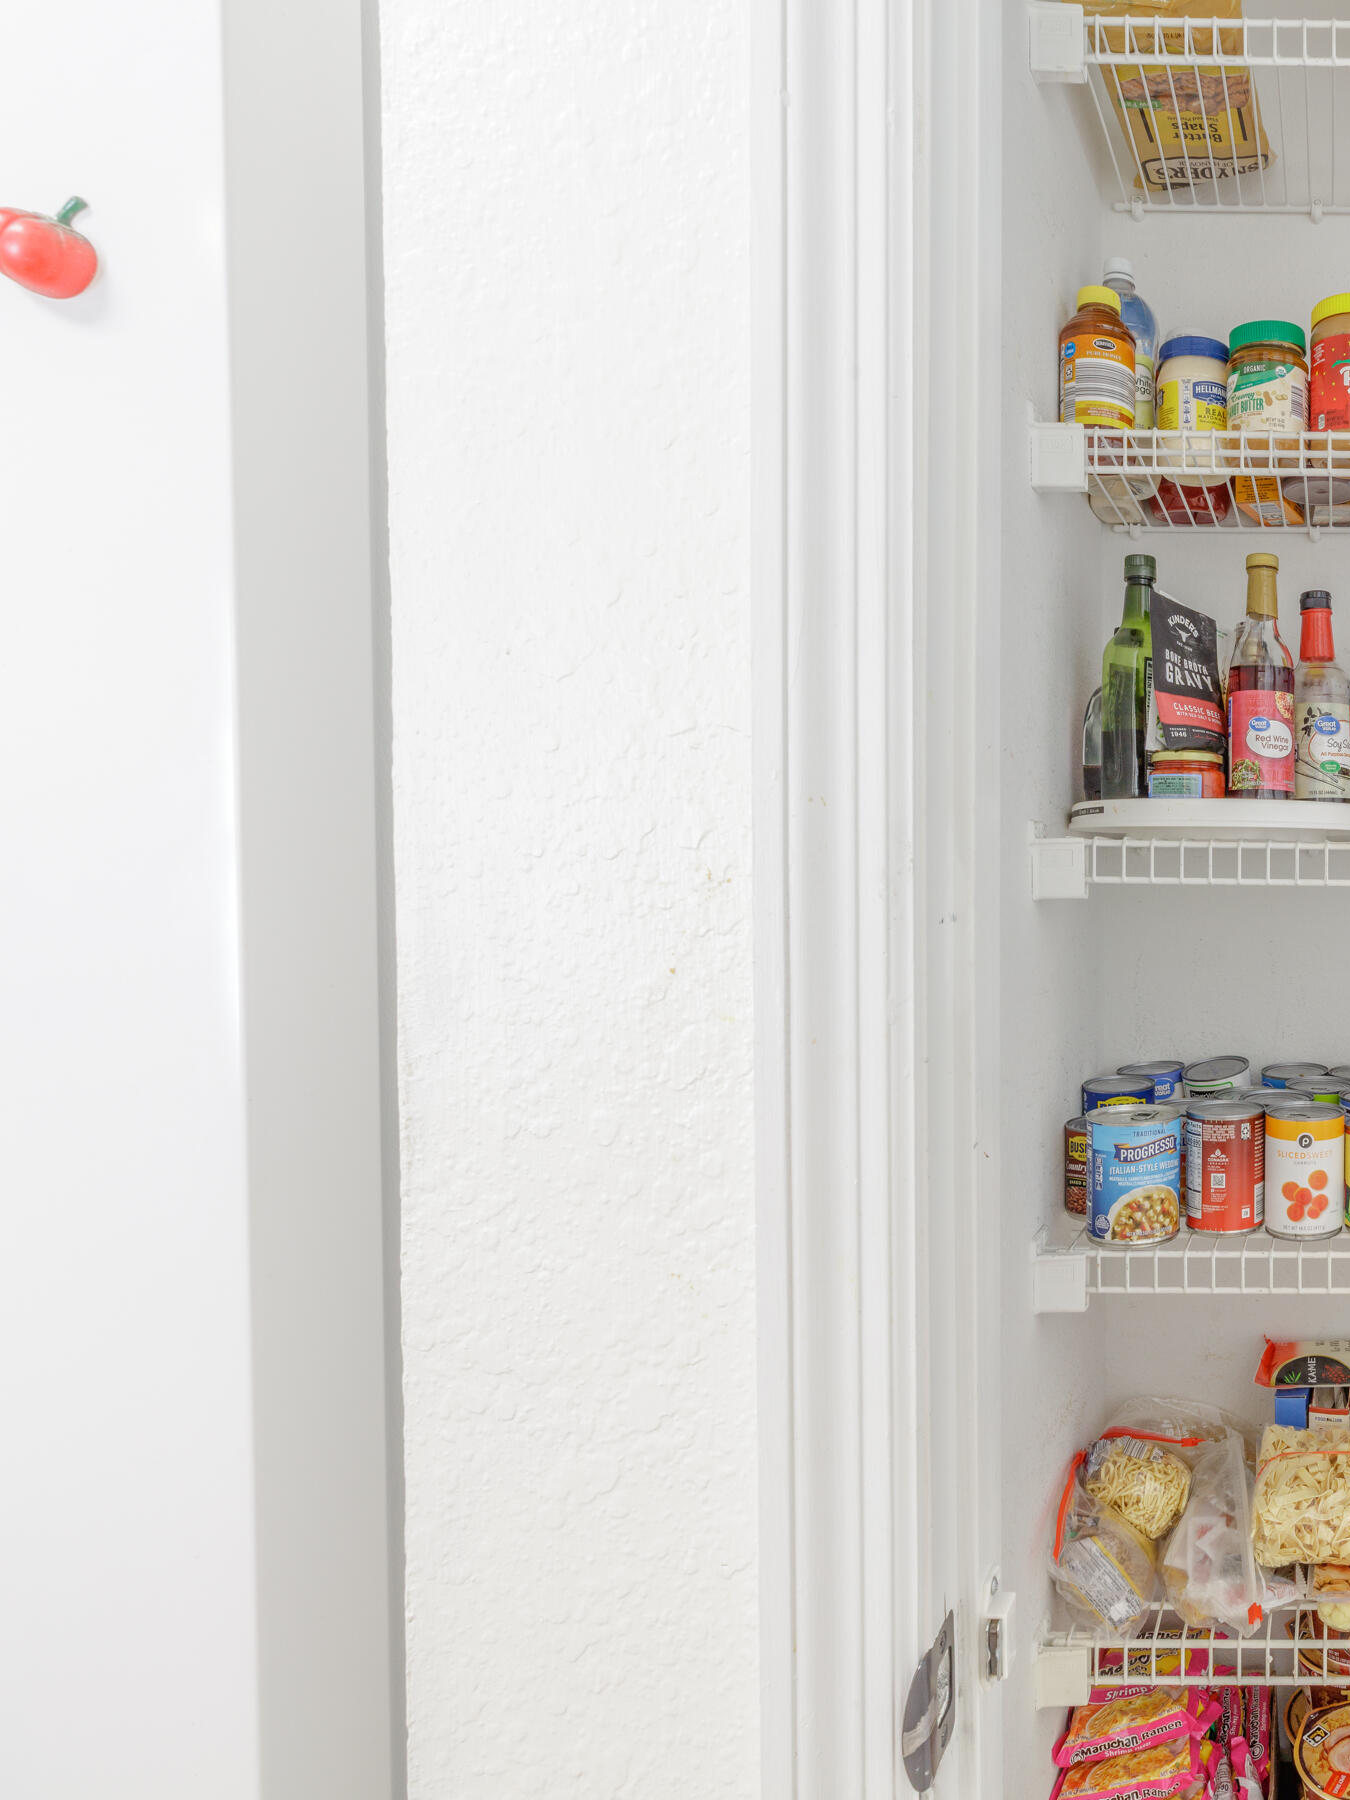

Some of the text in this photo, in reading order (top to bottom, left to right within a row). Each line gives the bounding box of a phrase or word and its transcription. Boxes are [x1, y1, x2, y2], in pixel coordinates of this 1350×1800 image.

[1173, 132, 1222, 143] Butter
[1243, 364, 1266, 374] ORGANIC
[1241, 398, 1264, 413] BUTTER
[1205, 407, 1226, 419] REAL
[1167, 614, 1199, 638] KINDER'S
[1165, 648, 1209, 675] BONE BROTH
[1165, 662, 1213, 694] GRAVY
[1173, 702, 1205, 716] CLASSIC
[1256, 734, 1289, 744] Red Wine
[1327, 738, 1342, 752] Soy
[1261, 742, 1289, 752] Vinegar
[1133, 1129, 1166, 1137] TRADITIONAL
[1120, 1136, 1175, 1162] PROGRESSO
[1277, 1149, 1306, 1159] SLICED
[1109, 1163, 1158, 1175] ITALIAN-STYLE
[1105, 1685, 1148, 1701] Shrimp
[1081, 1719, 1183, 1757] Maruchan Ramen
[1104, 1747, 1133, 1758] Shrimp
